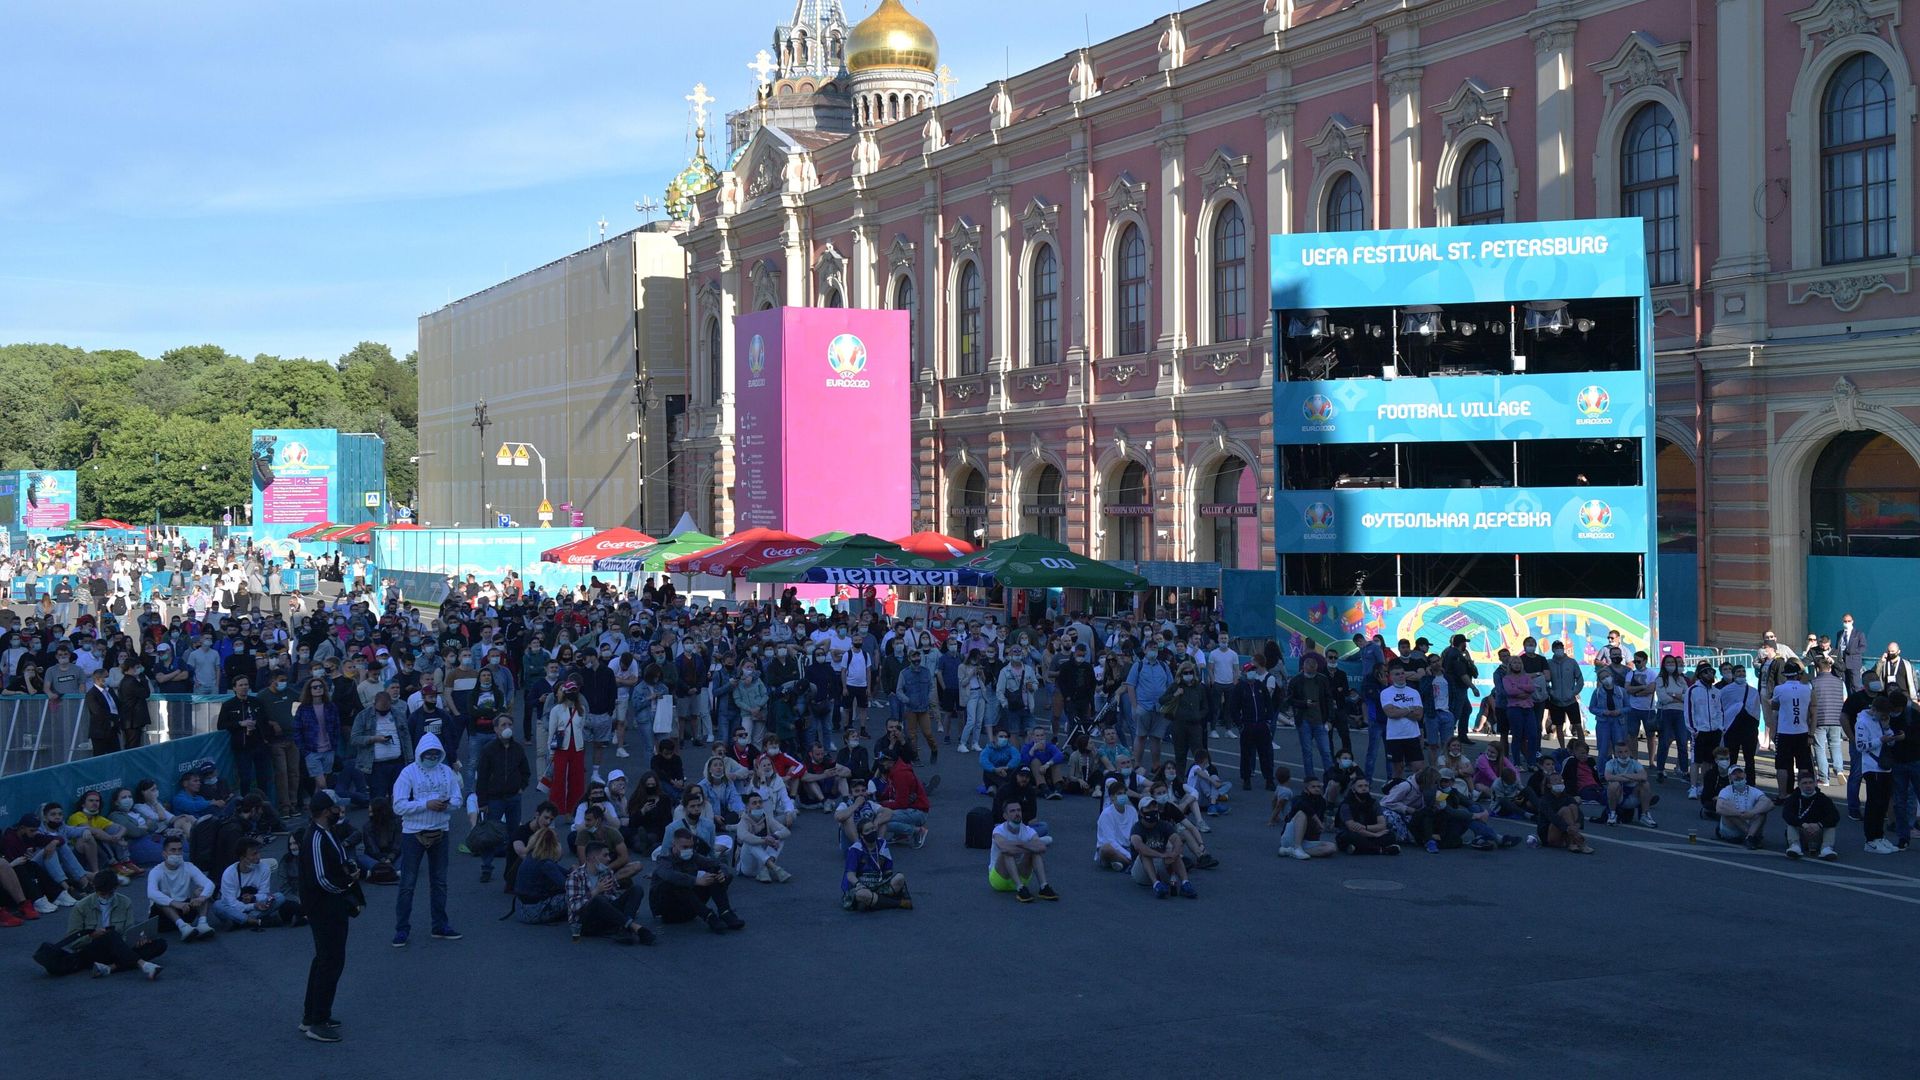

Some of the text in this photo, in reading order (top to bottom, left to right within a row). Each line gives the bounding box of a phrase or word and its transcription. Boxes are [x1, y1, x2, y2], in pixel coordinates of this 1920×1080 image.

[1301, 235, 1608, 266] UEFA FESTIVAL ST. PETERSBURG
[826, 378, 870, 388] EURO2020
[1377, 400, 1531, 420] FOOTBALL VILLAGE
[1201, 506, 1254, 514] GALLERY of AMBER
[1361, 512, 1552, 530] ФУТБОЛЬНАЯ ДЕРЕВНЯ
[821, 567, 960, 586] Heineken
[1792, 697, 1800, 725] USA
